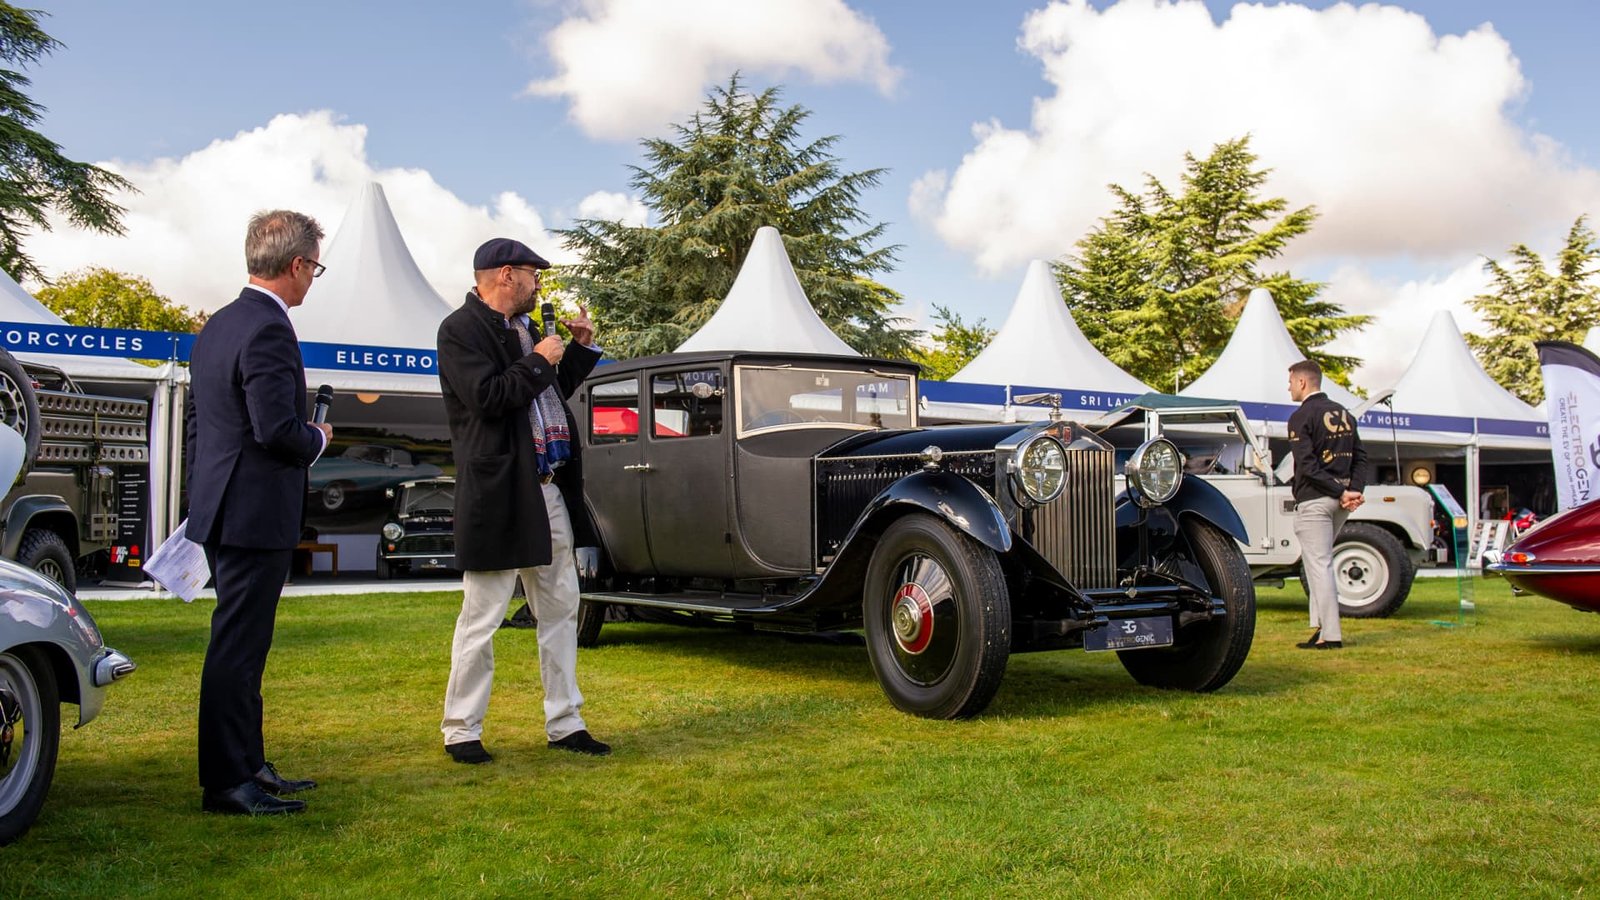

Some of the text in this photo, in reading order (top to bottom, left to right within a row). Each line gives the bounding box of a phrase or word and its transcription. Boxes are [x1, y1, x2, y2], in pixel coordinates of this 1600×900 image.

[0, 329, 143, 351] ORCYCLES
[336, 350, 438, 369] ELECTRO
[1080, 395, 1101, 406] SRI
[1357, 414, 1411, 426] ZY HORSE
